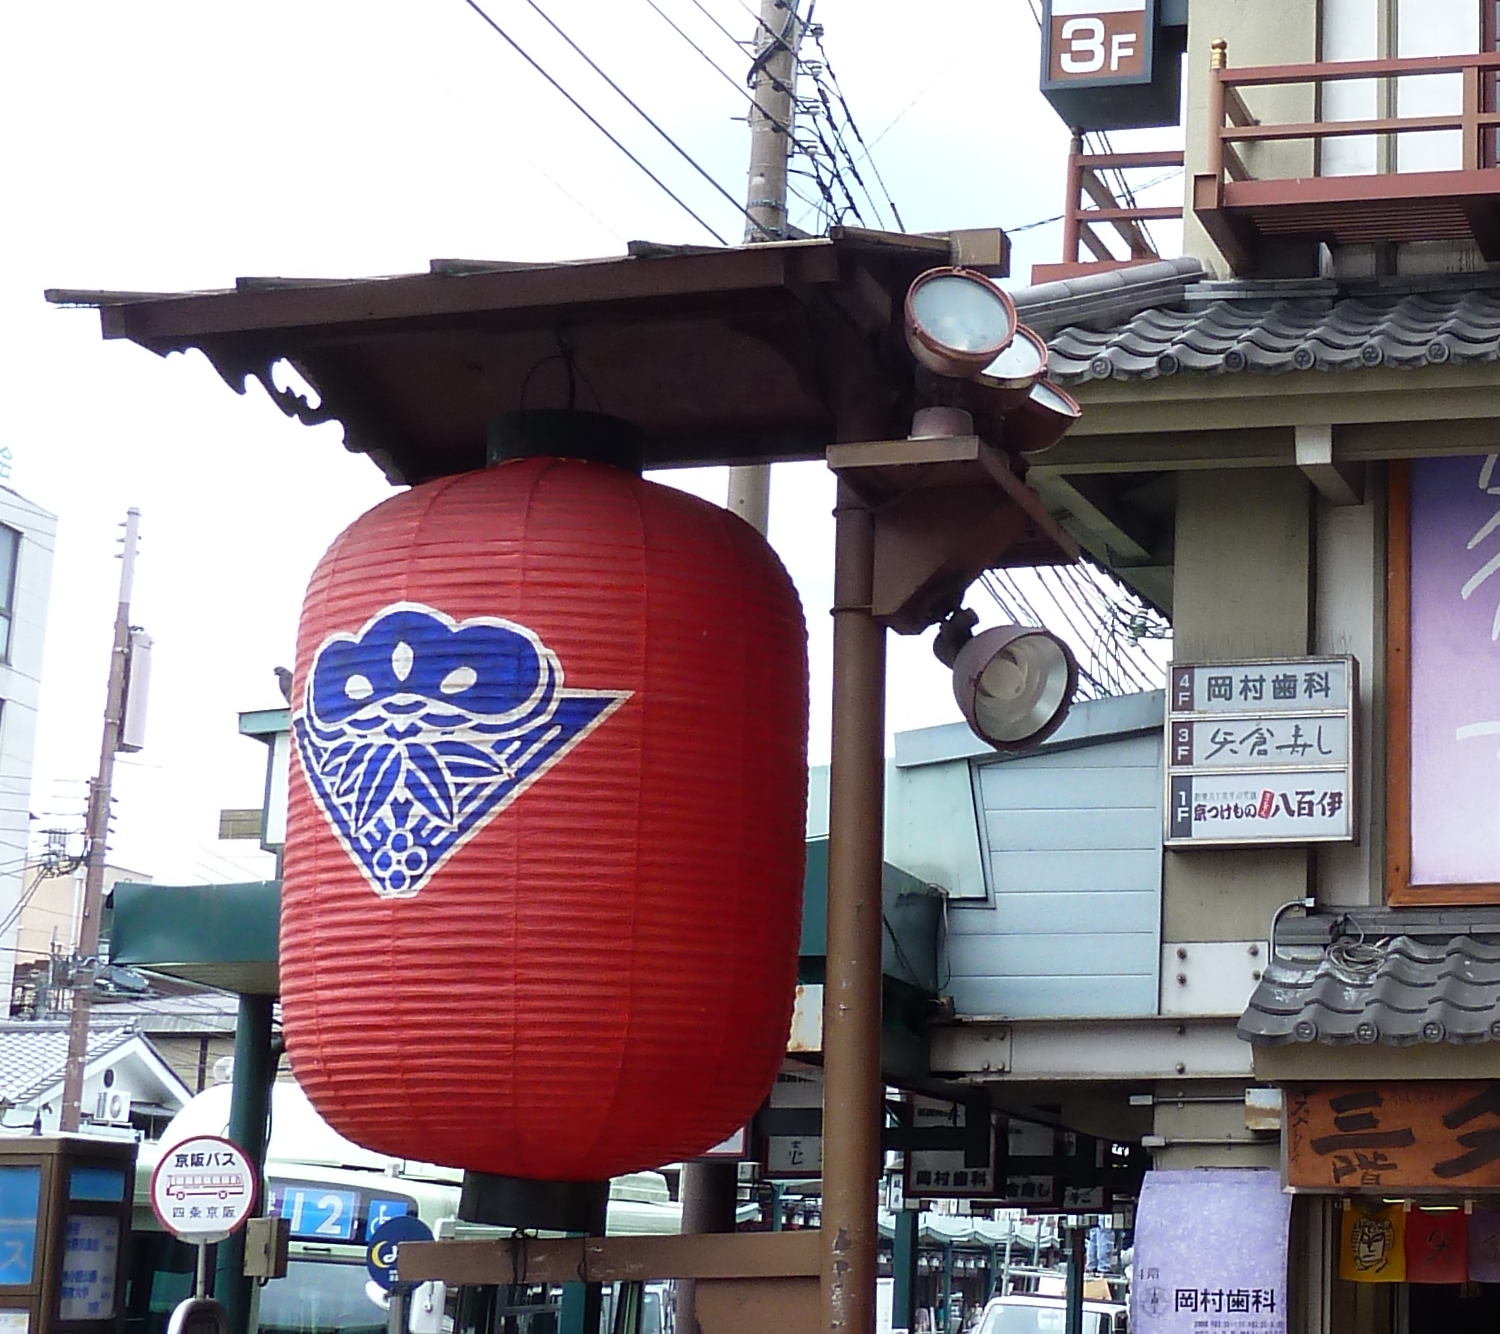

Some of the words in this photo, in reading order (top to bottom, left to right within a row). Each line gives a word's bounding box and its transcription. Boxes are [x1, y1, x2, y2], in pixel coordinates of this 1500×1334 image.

[1060, 16, 1137, 75] 3F
[1207, 672, 1331, 702] 岡村歯科
[1204, 724, 1332, 760] 矢倉寿し
[1271, 790, 1343, 818] 八百伊
[174, 1153, 236, 1168] 京阪バス
[172, 1206, 236, 1218] 四条京阪
[291, 1192, 343, 1234] 12
[1175, 1288, 1276, 1313] 岡村歯科
